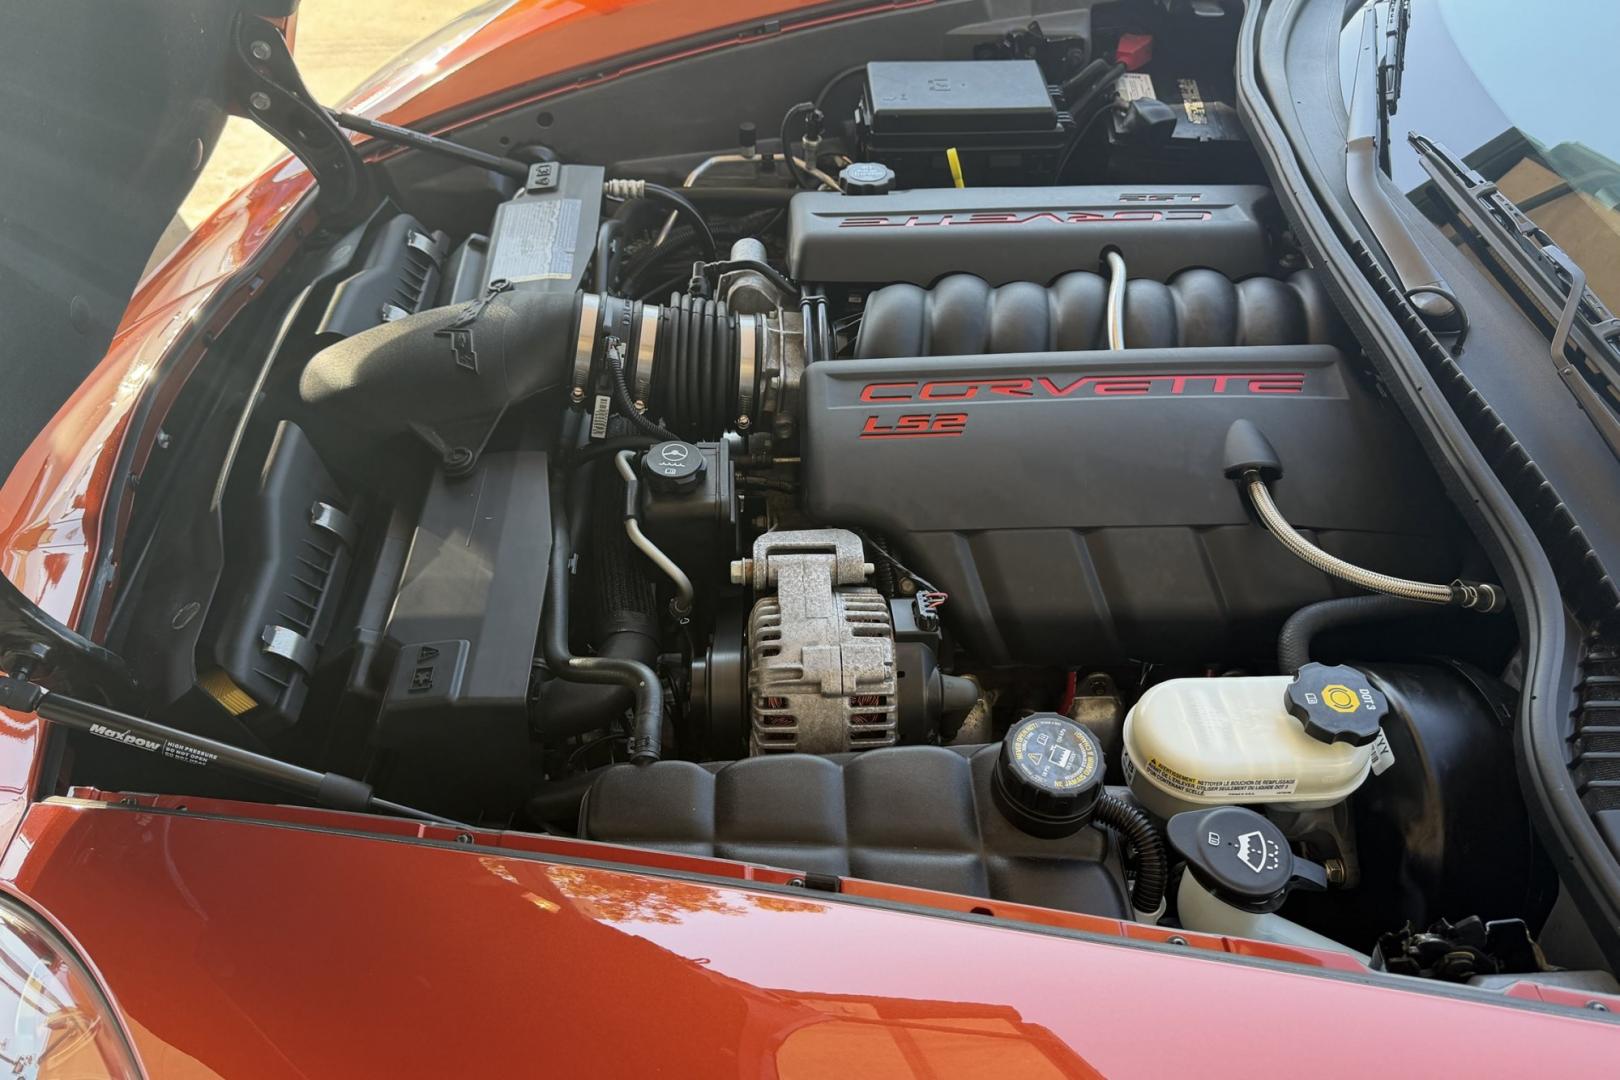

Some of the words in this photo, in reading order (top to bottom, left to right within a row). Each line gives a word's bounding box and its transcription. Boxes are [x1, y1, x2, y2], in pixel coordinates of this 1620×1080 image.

[839, 210, 1212, 228] CORVETTE
[859, 372, 1306, 401] CORVETTE
[860, 412, 969, 438] LS2
[1359, 688, 1374, 705] DOT
[1366, 703, 1377, 711] 3
[89, 723, 161, 752] Maxpow
[167, 741, 184, 752] HIGH
[184, 746, 218, 760] PRESSURE
[190, 754, 208, 762] OPEN
